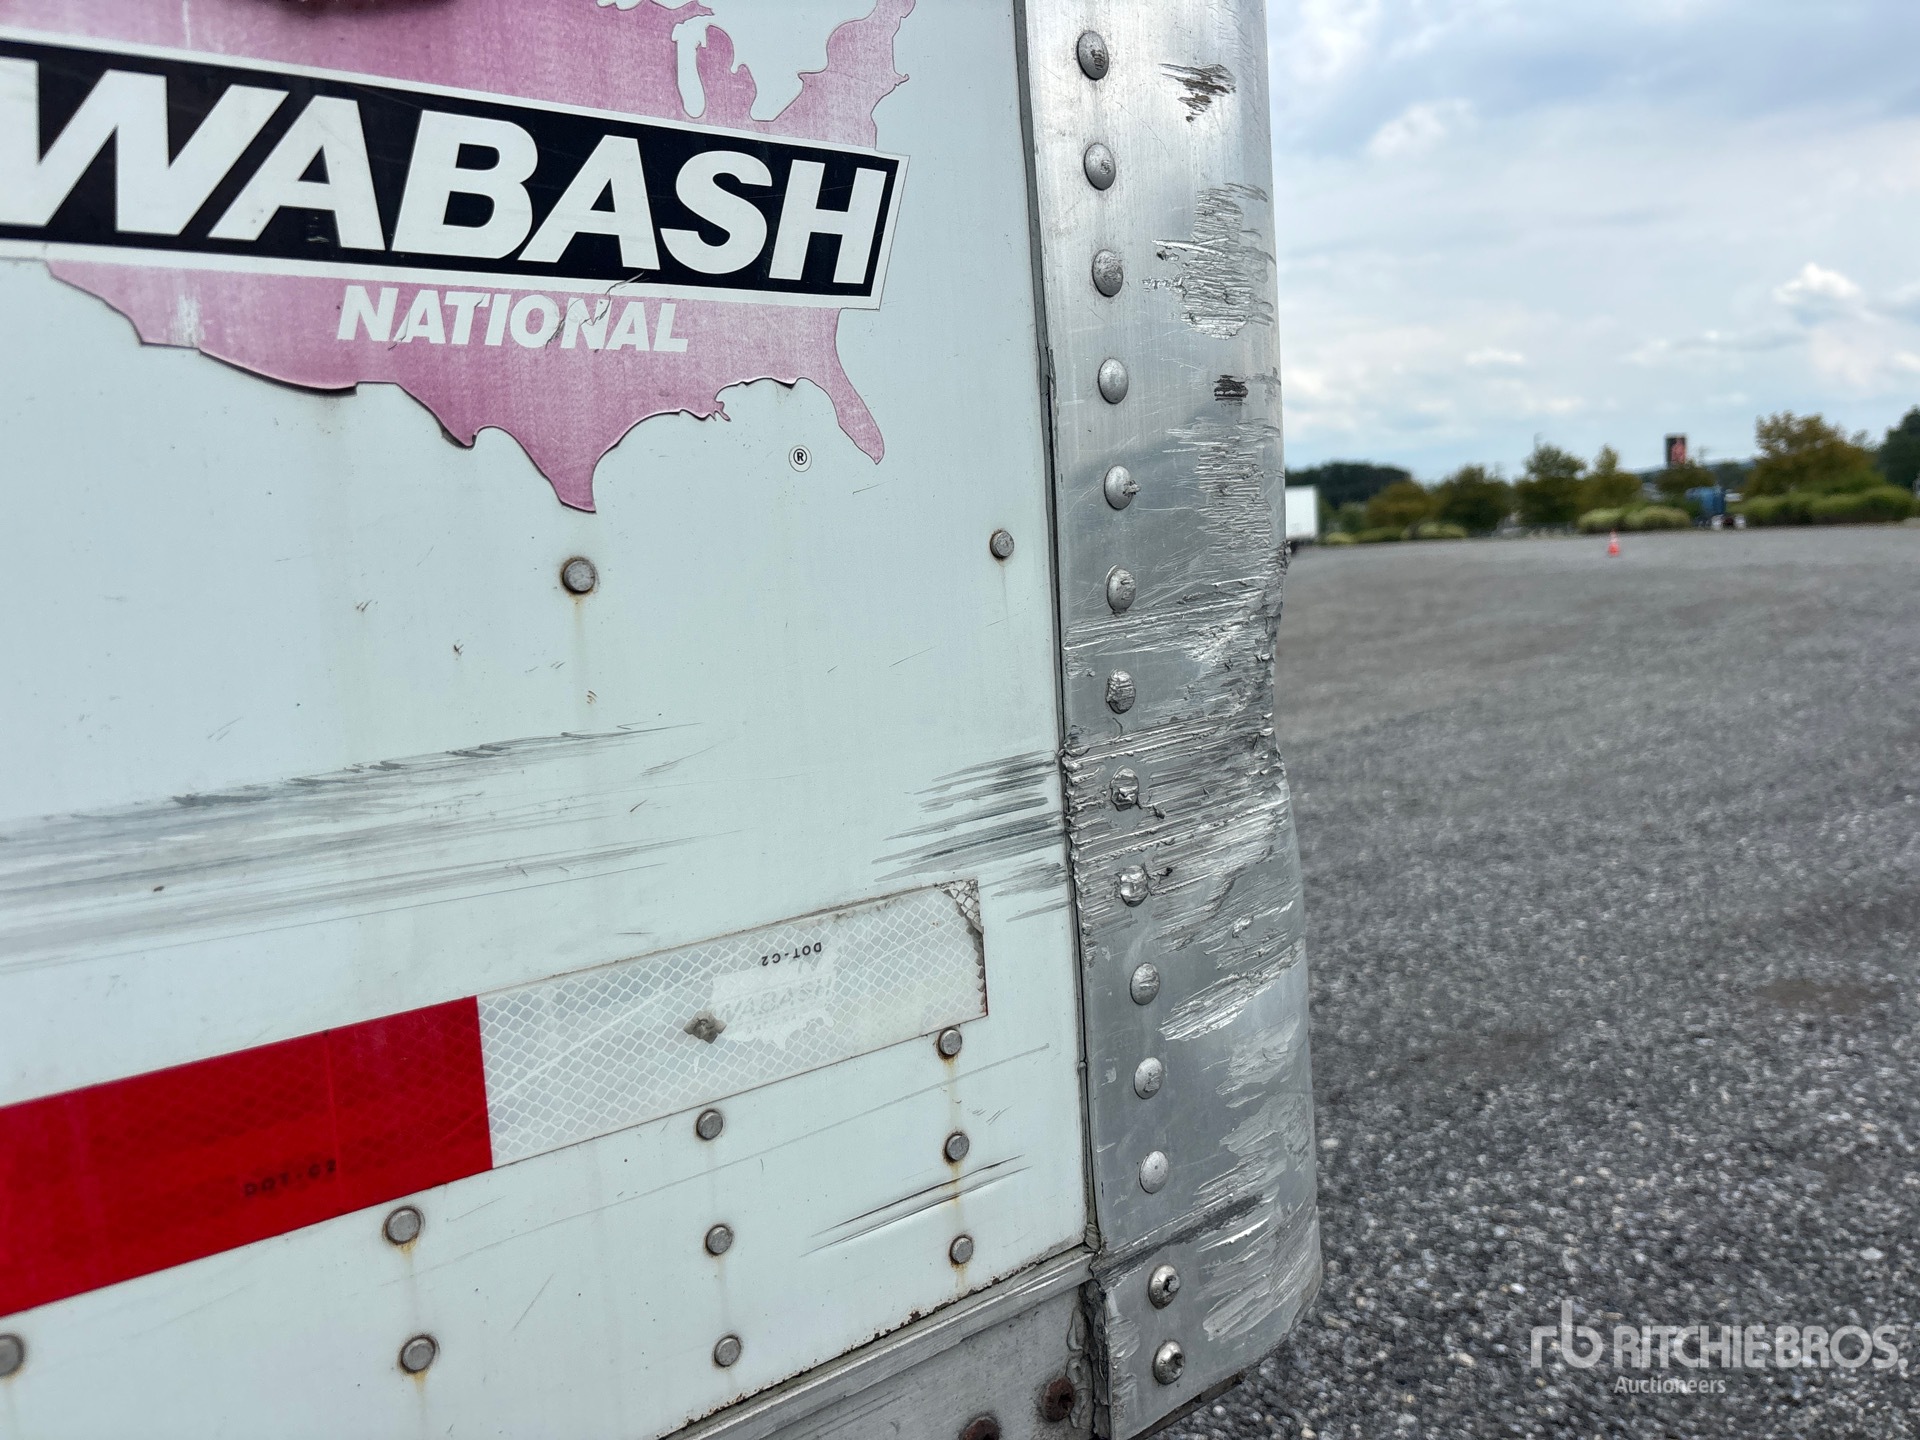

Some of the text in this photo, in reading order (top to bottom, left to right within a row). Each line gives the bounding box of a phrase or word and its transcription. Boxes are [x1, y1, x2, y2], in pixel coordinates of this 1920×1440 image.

[0, 57, 887, 284] WABASH
[337, 285, 688, 353] NATIONAL
[761, 942, 822, 967] DOT-C2
